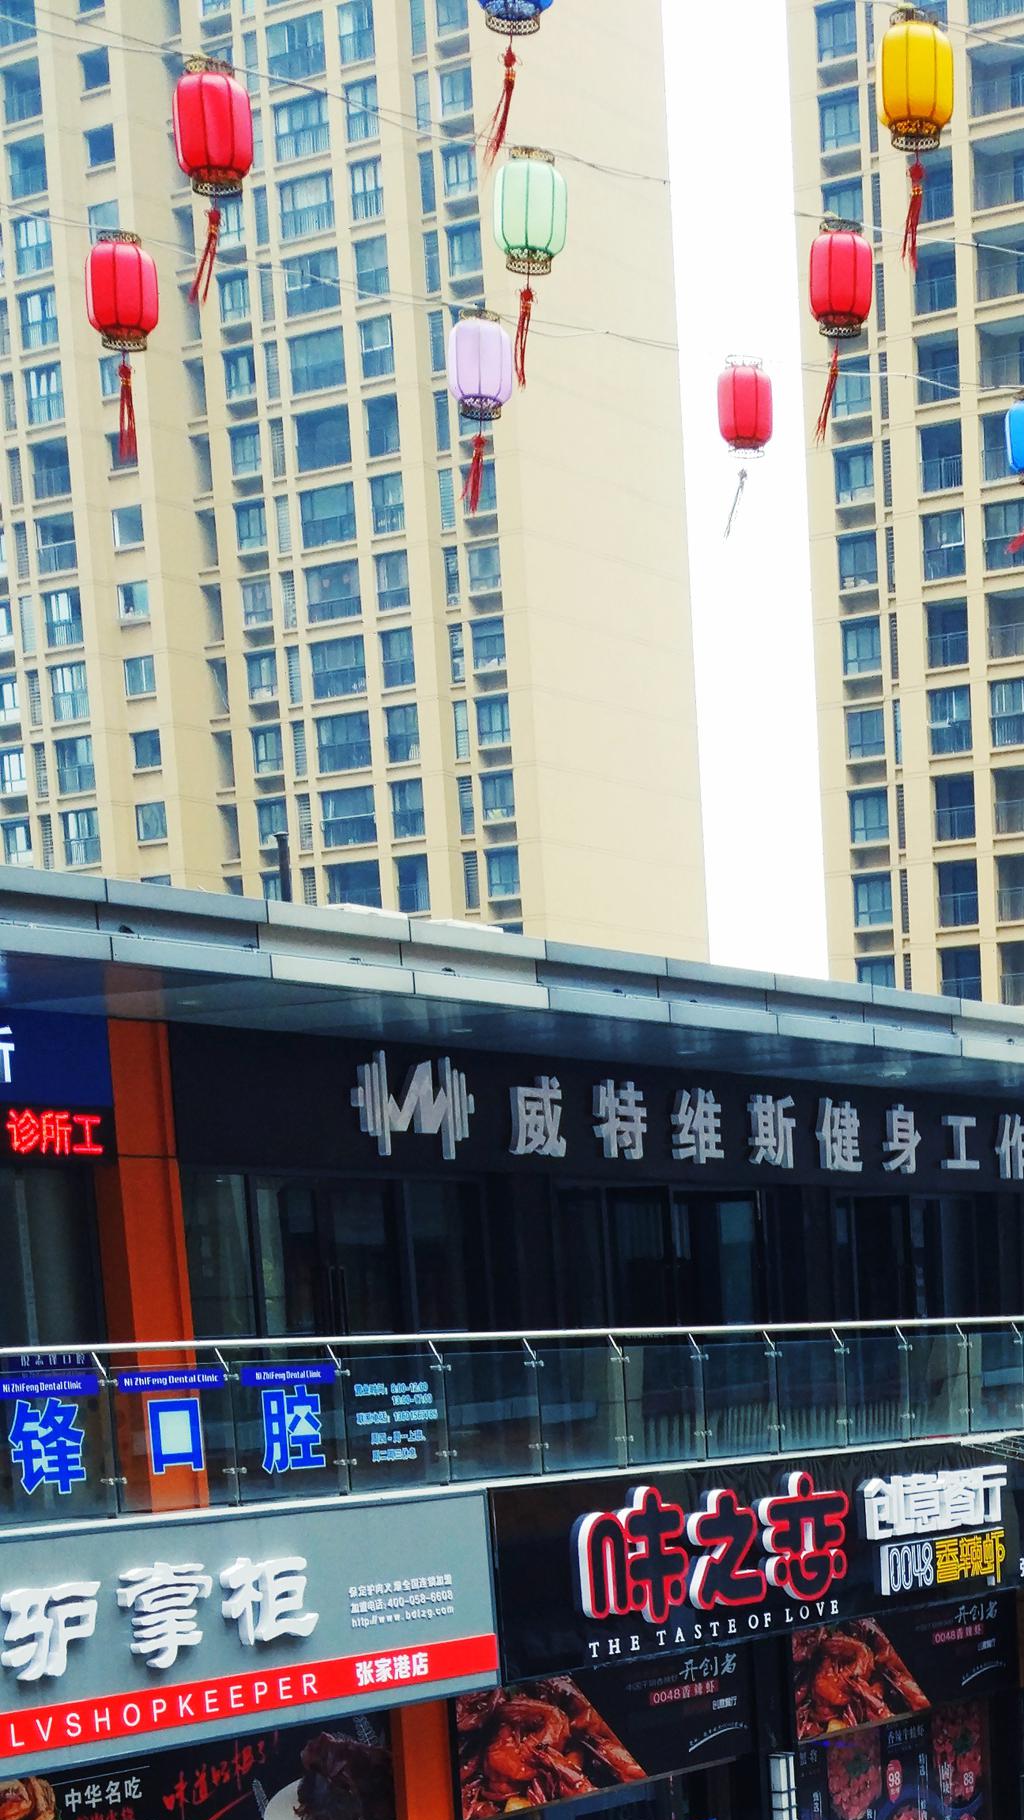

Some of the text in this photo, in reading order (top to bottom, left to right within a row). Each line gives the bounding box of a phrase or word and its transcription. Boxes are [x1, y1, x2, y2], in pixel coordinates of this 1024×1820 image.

[6, 1108, 103, 1156] 诊所工
[40, 1381, 63, 1391] Dental
[168, 1374, 196, 1384] Dental
[286, 1370, 305, 1379] Dental
[858, 1464, 1008, 1541] 创意餐厅
[573, 1471, 849, 1624] 味之恋
[0, 1556, 319, 1681] 驴掌柜
[588, 1599, 841, 1659] THE TASTE OF LOVE
[355, 1652, 429, 1687] 张家港店
[9, 1672, 319, 1749] LVSHOPKEEPER
[64, 1776, 143, 1813] 中华名吃
[887, 1767, 901, 1789] 98
